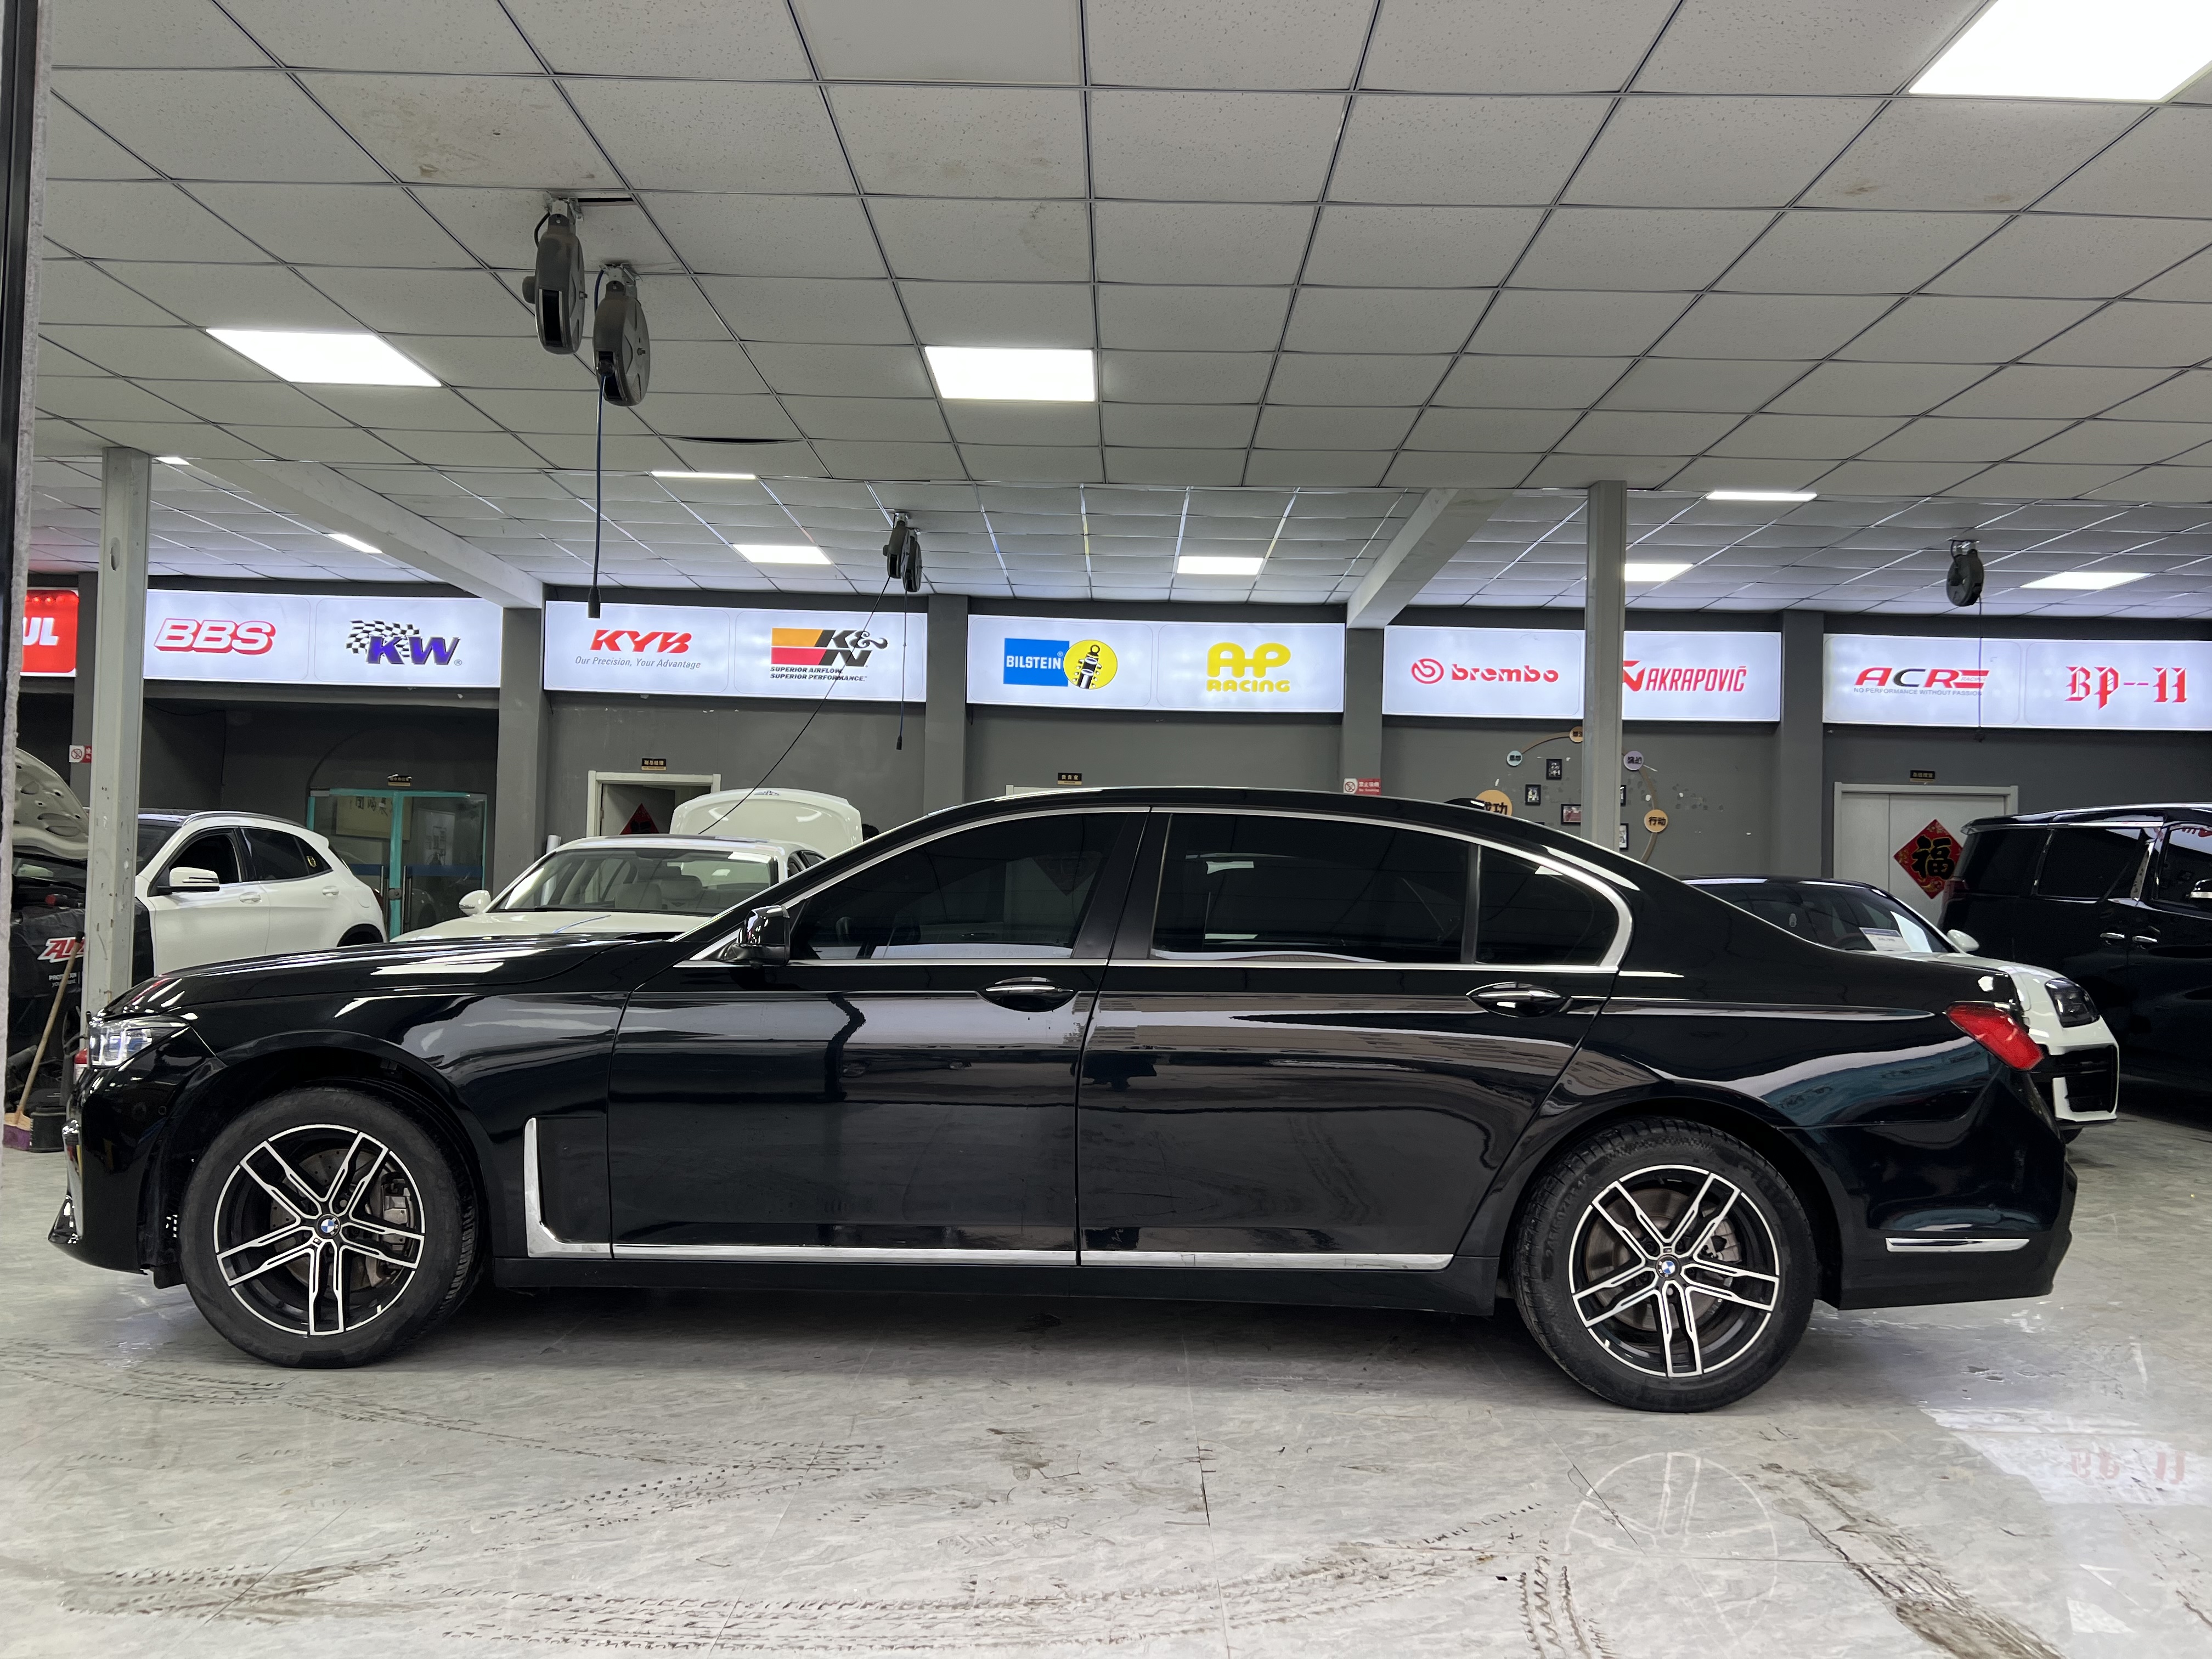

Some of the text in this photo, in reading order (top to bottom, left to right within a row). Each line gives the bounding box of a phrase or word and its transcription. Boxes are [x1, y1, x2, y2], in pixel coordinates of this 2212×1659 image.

[154, 618, 276, 655] BBS
[590, 629, 692, 653] KYB
[365, 636, 460, 665] KW
[575, 656, 701, 669] Our Precision, Your Advantage
[1006, 656, 1061, 669] BILSTEIN
[1451, 663, 1559, 682] brembo
[1206, 679, 1290, 692] RACING
[1649, 816, 1666, 826] 行动
[1911, 834, 1955, 880] 福
